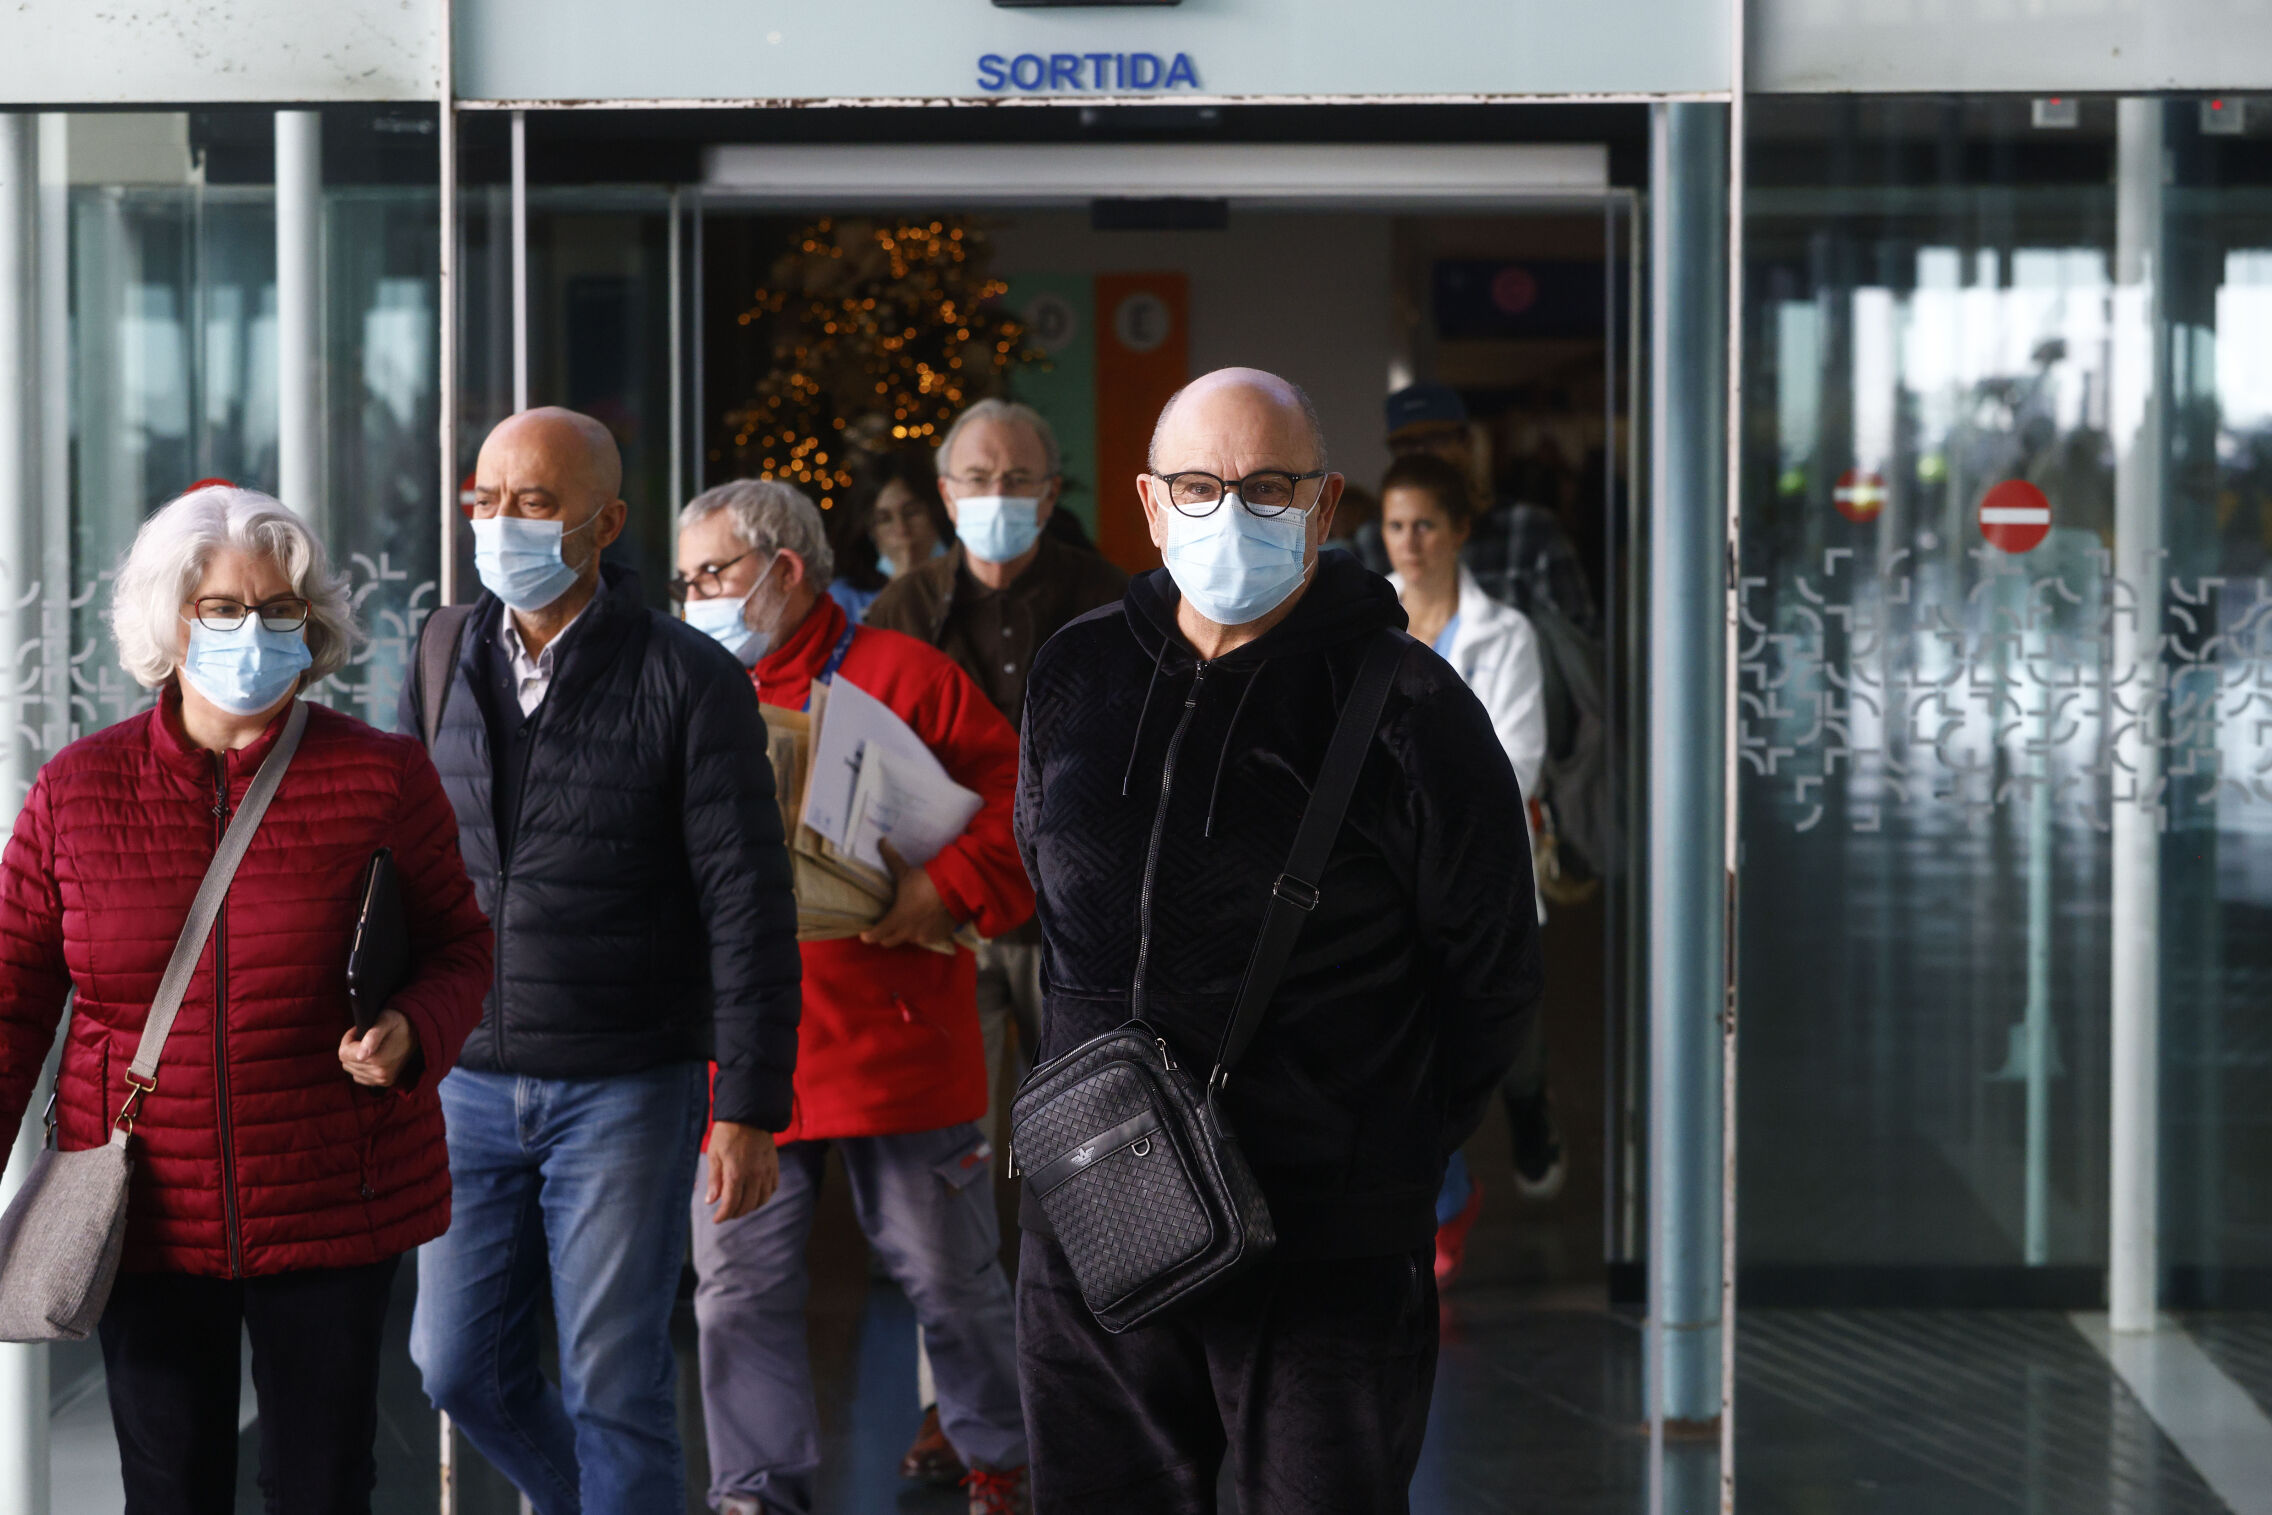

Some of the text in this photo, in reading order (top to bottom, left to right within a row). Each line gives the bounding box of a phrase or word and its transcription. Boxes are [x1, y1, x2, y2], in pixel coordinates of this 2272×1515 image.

[977, 52, 1199, 91] SORTIDA
[1038, 303, 1067, 340] D
[1129, 303, 1156, 342] E
